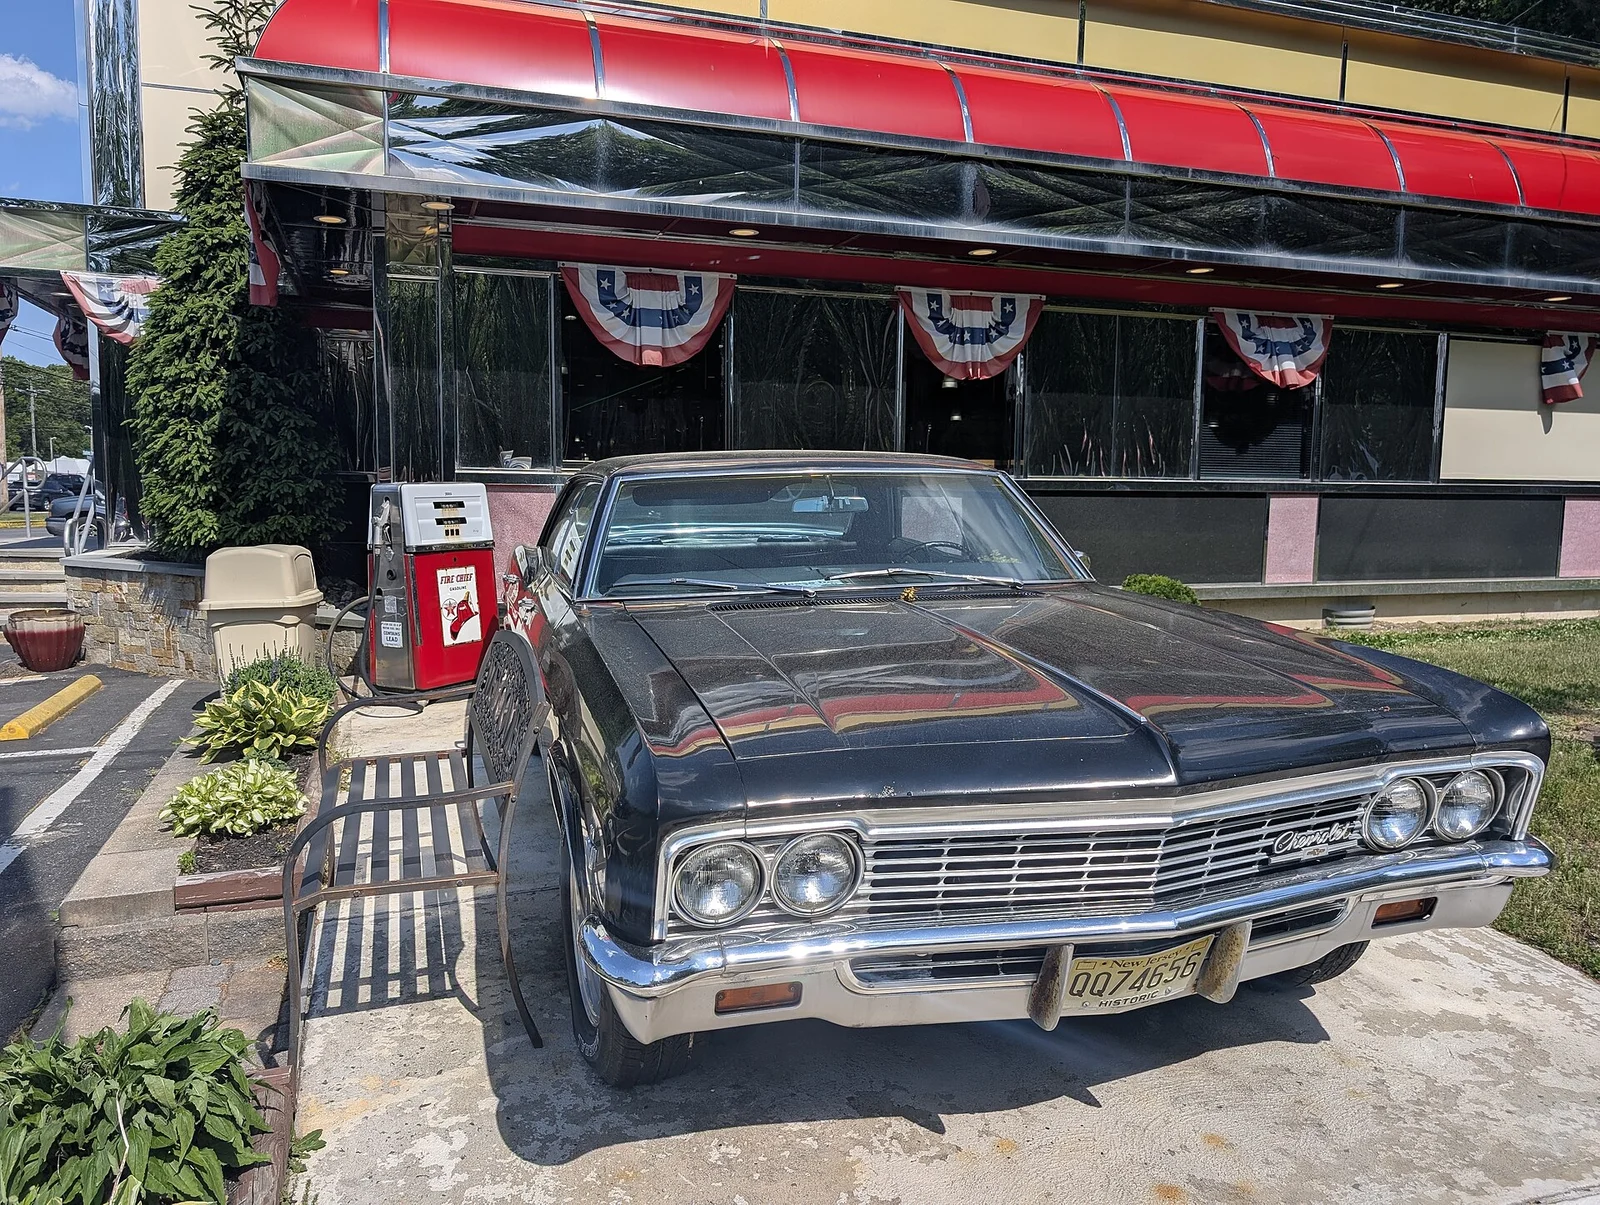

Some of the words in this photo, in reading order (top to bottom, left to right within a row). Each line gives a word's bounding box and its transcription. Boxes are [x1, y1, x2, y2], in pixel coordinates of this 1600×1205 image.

[440, 575, 455, 584] FIRE
[456, 573, 473, 582] CHIEF
[1274, 822, 1353, 854] Chevrolet
[1109, 959, 1144, 969] New
[1143, 949, 1182, 968] Jersey
[1069, 952, 1202, 997] QQ74656
[1098, 991, 1160, 1007] HISTORIC
